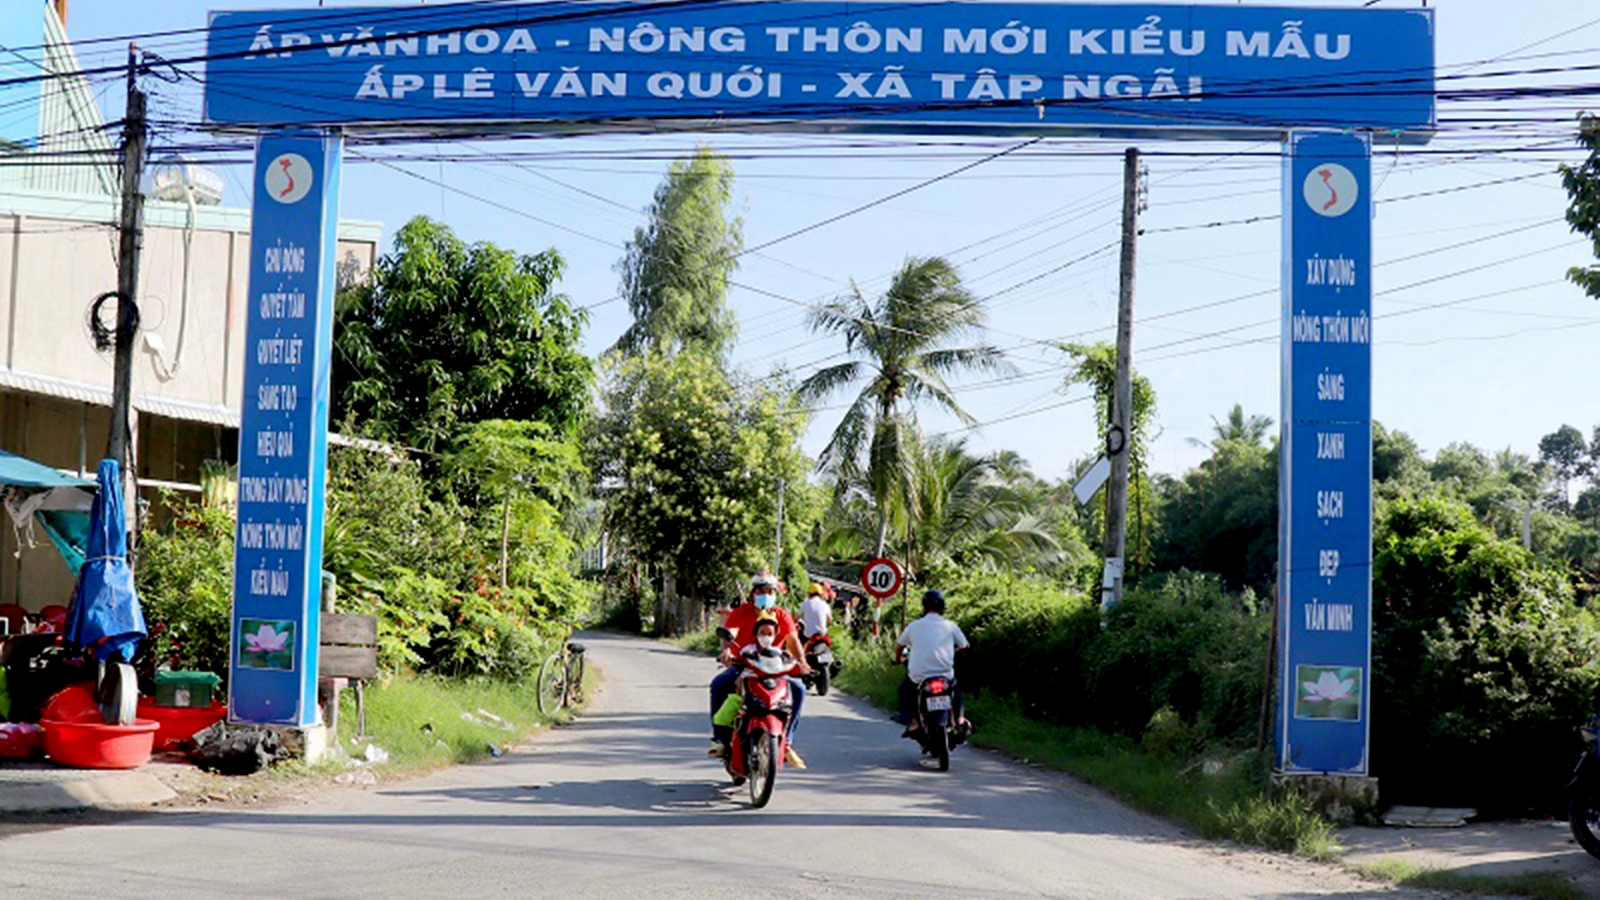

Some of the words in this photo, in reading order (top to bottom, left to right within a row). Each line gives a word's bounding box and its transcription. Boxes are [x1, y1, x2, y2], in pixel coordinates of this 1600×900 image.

[320, 26, 419, 57] VĂN
[588, 22, 746, 52] NÔNG
[766, 21, 922, 52] THÔN
[943, 20, 1046, 54] MỚI
[1069, 15, 1205, 55] KIỂU
[1226, 20, 1350, 60] MẪU
[354, 64, 424, 99] ẤP
[433, 66, 495, 98] LÊ
[515, 66, 627, 98] VĂN
[646, 64, 781, 99] QUỚI
[834, 65, 912, 98] XÃ
[1063, 68, 1203, 102] NGÃI
[258, 377, 280, 410] SÁNG
[281, 385, 297, 418] TẠO
[1317, 366, 1345, 401] SÁNG
[257, 425, 277, 464] HIỆU
[278, 421, 293, 458] QUẢ
[1317, 432, 1345, 459] XANH
[241, 477, 267, 502] TRONG
[1317, 491, 1343, 526] SẠCH
[1319, 549, 1340, 586] ĐẸP
[1305, 597, 1326, 631] VĂN
[1327, 604, 1353, 631] MINH
